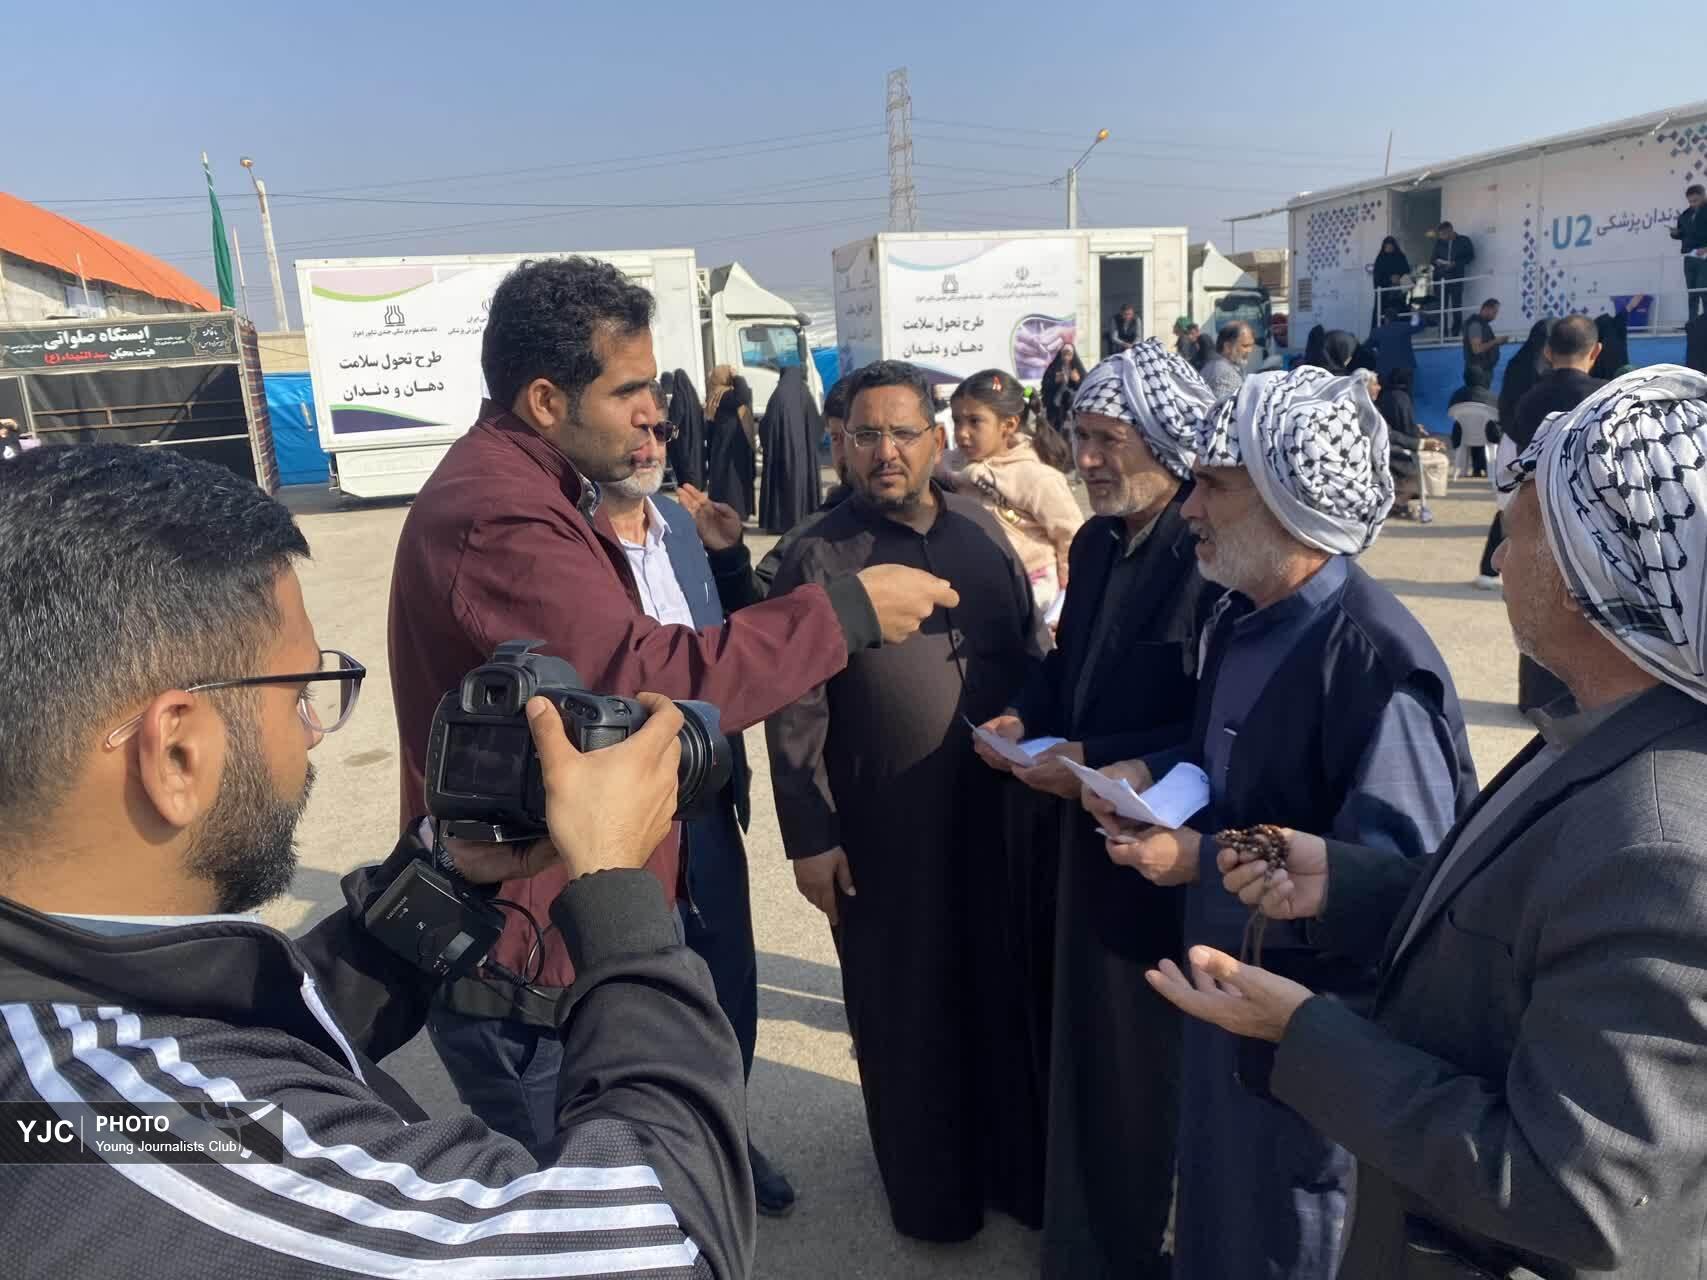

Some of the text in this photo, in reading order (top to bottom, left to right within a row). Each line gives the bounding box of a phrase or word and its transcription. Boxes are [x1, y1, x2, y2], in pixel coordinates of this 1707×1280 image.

[1552, 213, 1593, 250] U2
[903, 315, 984, 332] طرح تحول سلامت
[43, 325, 150, 350] ایستگاه صلواتی
[339, 350, 442, 370] طرح تحول سلامت
[903, 341, 983, 358] دهان و دندان
[343, 379, 445, 401] دهان و دندان
